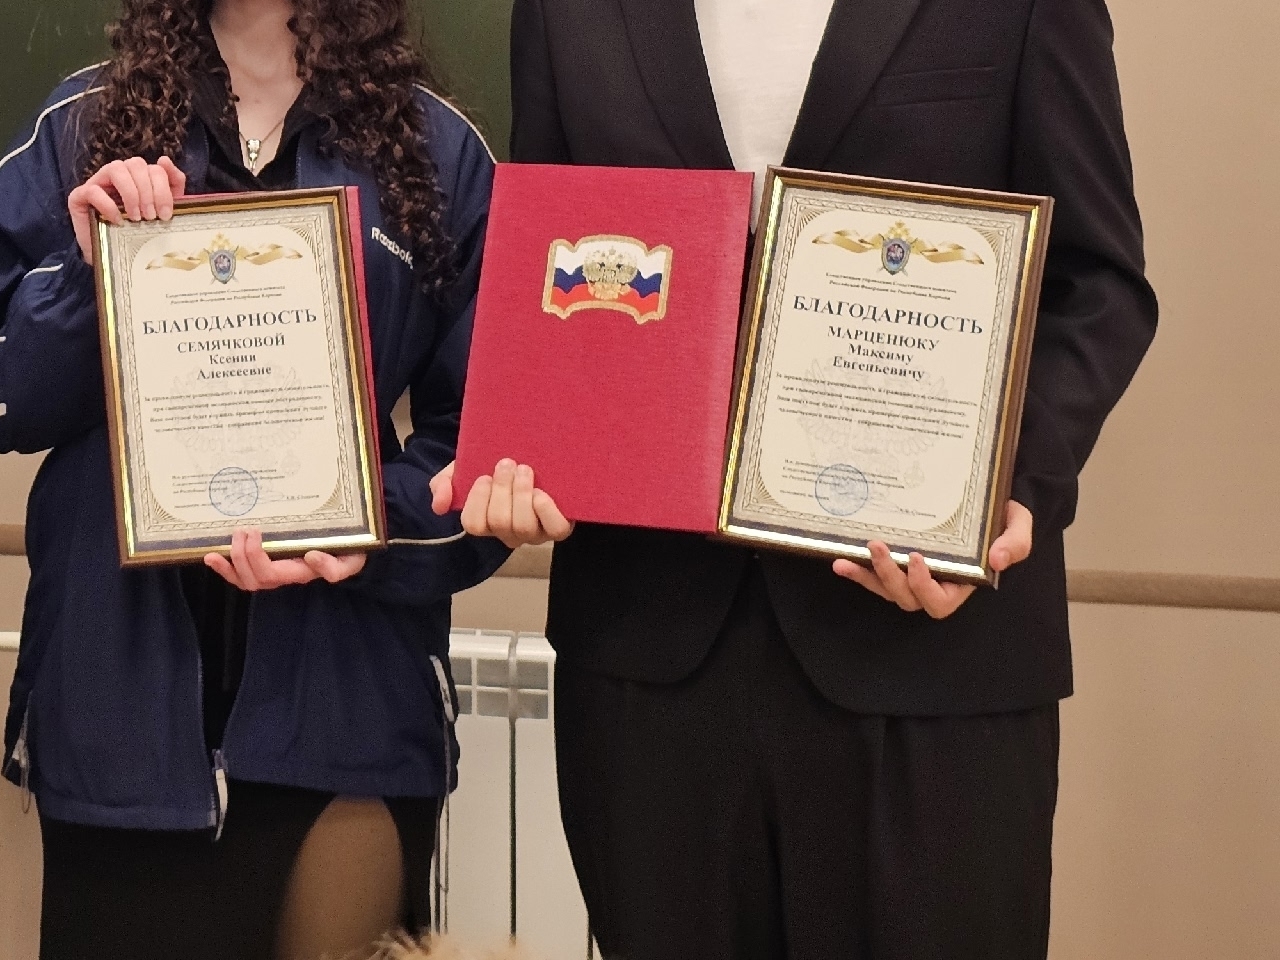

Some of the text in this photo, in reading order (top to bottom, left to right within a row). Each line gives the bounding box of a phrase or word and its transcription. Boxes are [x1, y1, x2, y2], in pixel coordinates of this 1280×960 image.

[371, 226, 413, 269] Reebok
[142, 308, 317, 335] БЛАГОДАРНОСТЬ
[793, 294, 983, 334] БЛАГОДАРНОСТЬ
[177, 332, 285, 354] СЕМЯЧКОВОЙ
[827, 325, 939, 351] МАРЦЕНЮКУ
[209, 352, 257, 365] Ксении
[848, 343, 914, 363] Максиму
[196, 366, 272, 381] Алексеевне
[832, 356, 925, 381] Евгеньевичу
